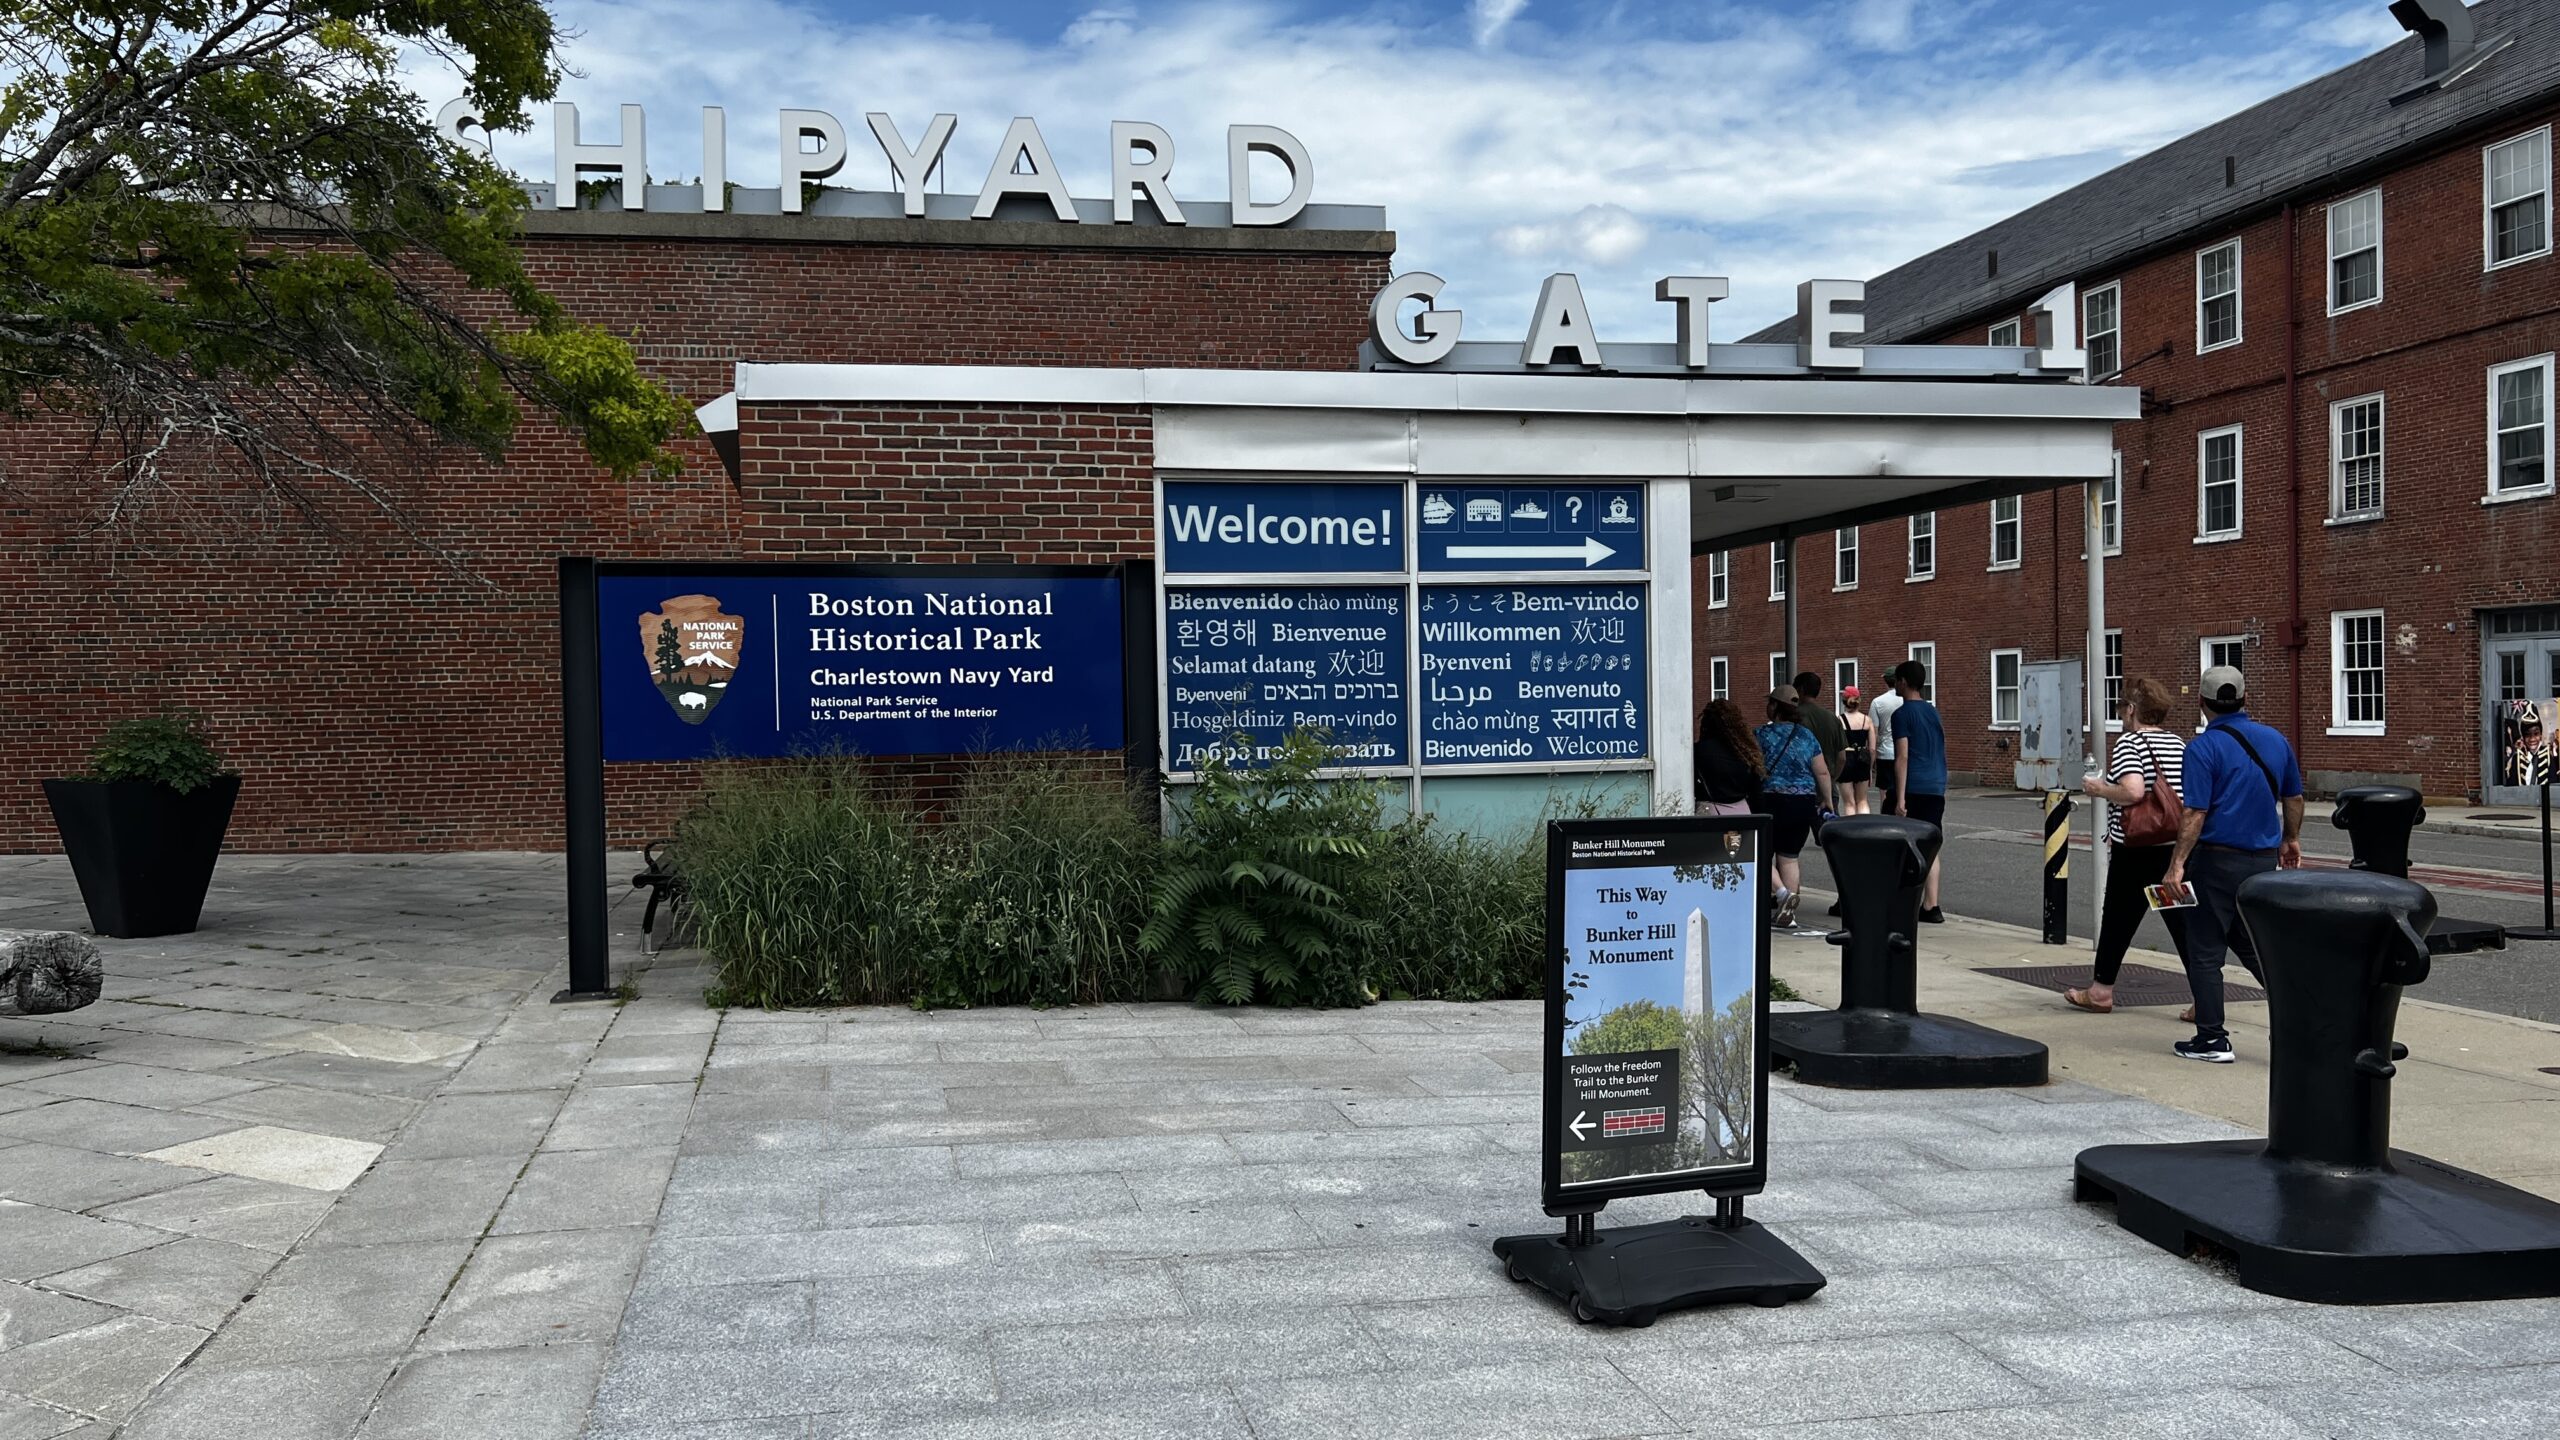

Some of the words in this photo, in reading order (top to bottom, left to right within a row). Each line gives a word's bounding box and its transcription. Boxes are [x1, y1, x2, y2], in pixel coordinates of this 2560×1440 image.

[1369, 272, 1865, 368] GATE
[2026, 281, 2086, 369] 1
[1168, 503, 1391, 546] Welcome!
[808, 592, 915, 616] Boston
[923, 591, 1054, 616] National
[1168, 592, 1294, 611] Bienvenido
[1297, 592, 1341, 611] chào
[1345, 592, 1399, 616] mừng
[1422, 593, 1507, 614] ようこそ
[1511, 590, 1640, 612] Bem-vindo
[682, 621, 739, 631] NATIONAL
[696, 631, 726, 641] PARK
[1176, 618, 1257, 648] 환영해
[1272, 622, 1387, 642] Bienvenue
[1422, 621, 1561, 642] Willkommen
[1570, 616, 1626, 645] 欢迎
[688, 641, 734, 650] SERVICE
[809, 626, 964, 652] Historical
[973, 626, 1042, 650] Park
[1172, 654, 1248, 675] Selamat
[1251, 653, 1317, 680] datang
[1327, 648, 1386, 678] 欢迎
[1421, 652, 1512, 677] Byenveni
[810, 667, 942, 686] Charlestown
[950, 667, 1001, 688] Navy
[1007, 665, 1054, 683] Yard
[1175, 686, 1248, 705] Byenveni
[1263, 683, 1327, 701] הבאים
[1334, 682, 1400, 700] ברוכים
[1431, 676, 1493, 708] مرحبا
[1518, 680, 1621, 699] Benvenuto
[810, 695, 862, 707] National
[865, 695, 892, 707] Park
[895, 695, 938, 706] Service
[811, 709, 835, 721] U.S.
[839, 709, 911, 722] Department
[914, 707, 928, 719] of
[930, 707, 951, 719] the
[954, 706, 998, 718] Interior
[1171, 710, 1286, 735] Hoşgeldiniz
[1292, 709, 1398, 729] Bem-vindo
[1431, 709, 1479, 731] chào
[1484, 708, 1540, 734] mừng
[1550, 707, 1620, 730] स्वागत
[1622, 699, 1637, 729] है
[1256, 743, 1396, 761] поовать
[1425, 737, 1533, 758] Bienvenido
[1546, 734, 1639, 756] Welcome
[1571, 851, 1592, 859] Boston
[1592, 850, 1617, 858] National
[1617, 849, 1643, 857] Historical
[1572, 840, 1604, 850] Bunker
[1604, 839, 1620, 849] Hill
[1621, 839, 1666, 849] Monument
[1596, 887, 1632, 904] This
[1634, 886, 1668, 906] Way
[1626, 909, 1638, 920] to
[1585, 925, 1645, 943] Bunker
[1646, 923, 1677, 941] Hill
[1587, 947, 1675, 965] Monument
[1570, 1063, 1603, 1075] Follow
[1603, 1062, 1620, 1073] the
[1622, 1060, 1662, 1072] Freedom
[1573, 1076, 1594, 1088] Trail
[1595, 1077, 1607, 1087] to
[1608, 1075, 1625, 1086] the
[1626, 1072, 1659, 1084] Bunker
[1580, 1089, 1597, 1101] Hill
[1598, 1086, 1652, 1099] Monument.
